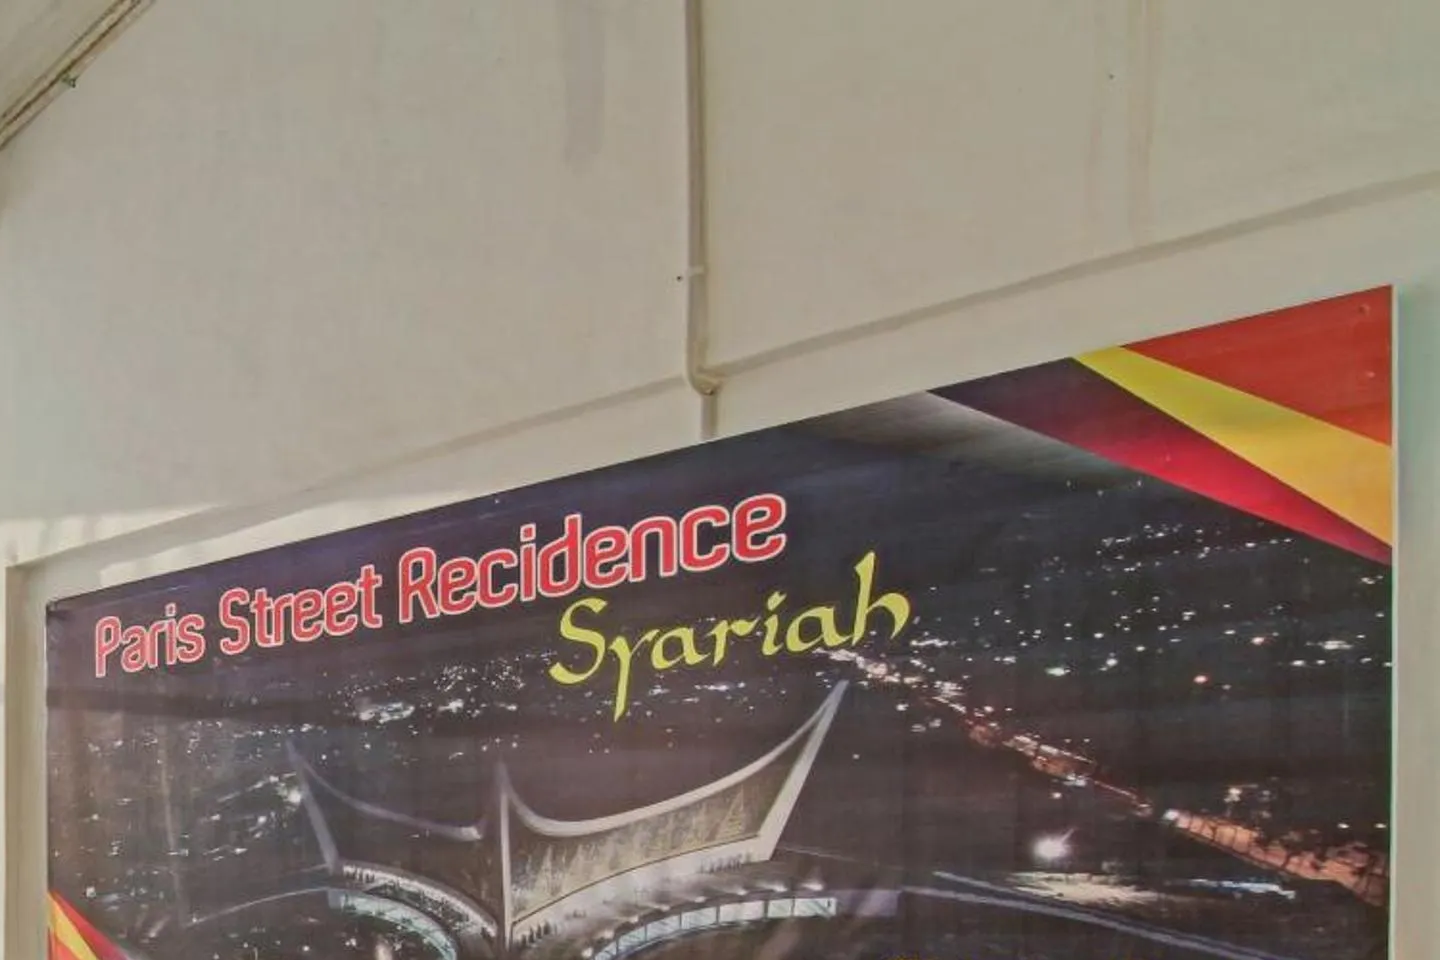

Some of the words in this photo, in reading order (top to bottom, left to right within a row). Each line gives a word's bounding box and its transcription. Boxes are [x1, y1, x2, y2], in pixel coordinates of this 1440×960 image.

[95, 604, 206, 678] Paris
[219, 586, 383, 655] Street
[399, 493, 786, 623] Recidence
[549, 550, 911, 723] Syariah
